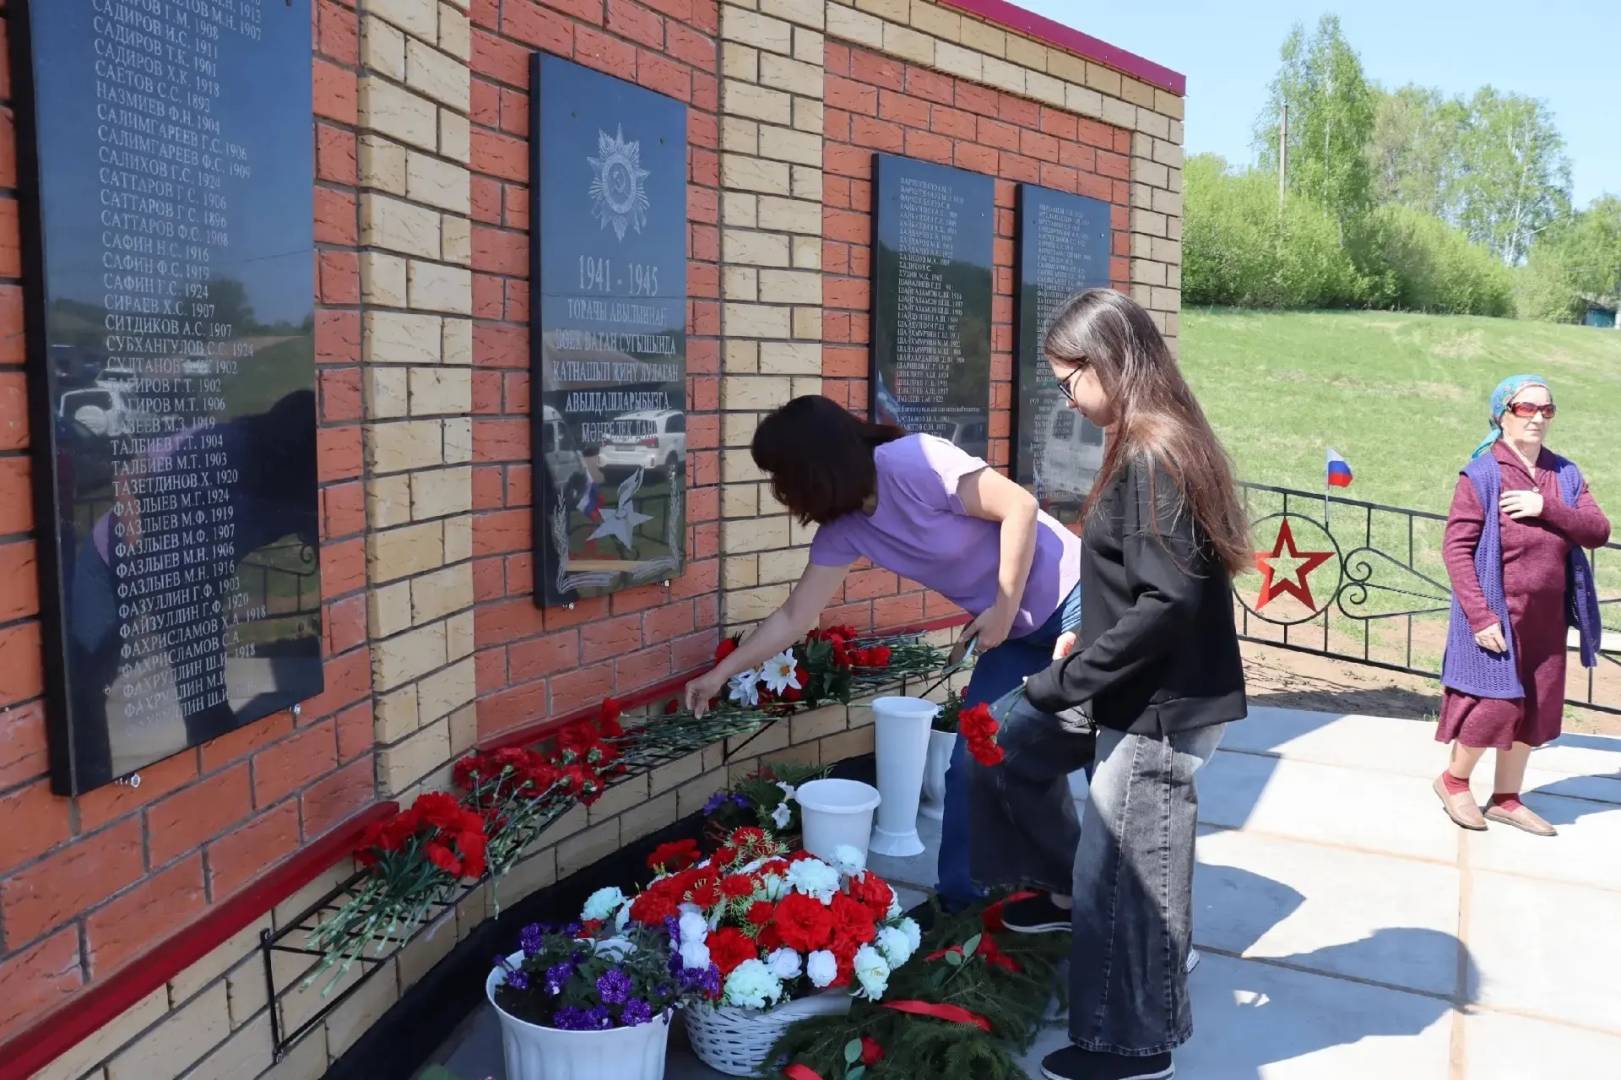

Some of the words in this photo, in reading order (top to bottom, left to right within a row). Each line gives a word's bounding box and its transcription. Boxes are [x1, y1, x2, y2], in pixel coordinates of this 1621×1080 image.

[93, 0, 161, 36] САДИРОВ
[93, 15, 162, 56] САДИРОВ
[94, 38, 163, 76] САДИРОВ
[96, 60, 153, 93] САЕТОВ
[96, 80, 165, 117] НАЗМИЕВ
[97, 103, 198, 147] САЛИМГАРЕЕВ
[98, 125, 199, 166] САЛИМГАРЕЕВ
[99, 146, 168, 177] САЛИХОВ
[99, 167, 174, 197] САТТАРОВ
[100, 189, 174, 217] САТТАРОВ
[100, 210, 175, 238] САТТАРОВ
[102, 231, 153, 254] САФИН
[102, 251, 153, 274] САФИН
[579, 255, 611, 292] 1941
[628, 264, 658, 296] 1945
[103, 273, 154, 295] САФИН
[105, 314, 179, 338] СИТДИКОВ
[106, 335, 204, 356] СУБХАНГУЛОВ
[553, 360, 610, 381] КАТНАШЫП
[110, 437, 172, 456] ТАЛБИЕВ
[201, 434, 223, 449] 1904
[111, 456, 173, 476] ТАЛБИЕВ
[176, 454, 201, 470] М.Т.
[205, 452, 227, 467] 1903
[112, 473, 198, 497] ТАЗЕТДИНОВ
[113, 495, 178, 517] ФАЗЛЫЕВ
[207, 489, 229, 504] 1924
[114, 514, 178, 538] ФАЗЛЫЕВ
[182, 510, 208, 527] М.Ф.
[115, 533, 179, 558] ФАЗЛЫЕВ
[182, 529, 209, 545] М.Ф.
[116, 554, 180, 578] ФАЗЛЫЕВ
[183, 547, 209, 565] М.Н.
[117, 573, 180, 598] ФАЗЛЫЕВ
[184, 566, 209, 583] М.Н.
[118, 589, 190, 619] ФАЗУЛЛИН
[119, 605, 199, 639] ФАЙЗУЛЛИН
[120, 618, 218, 659] ФАХРИСЛАМОВ
